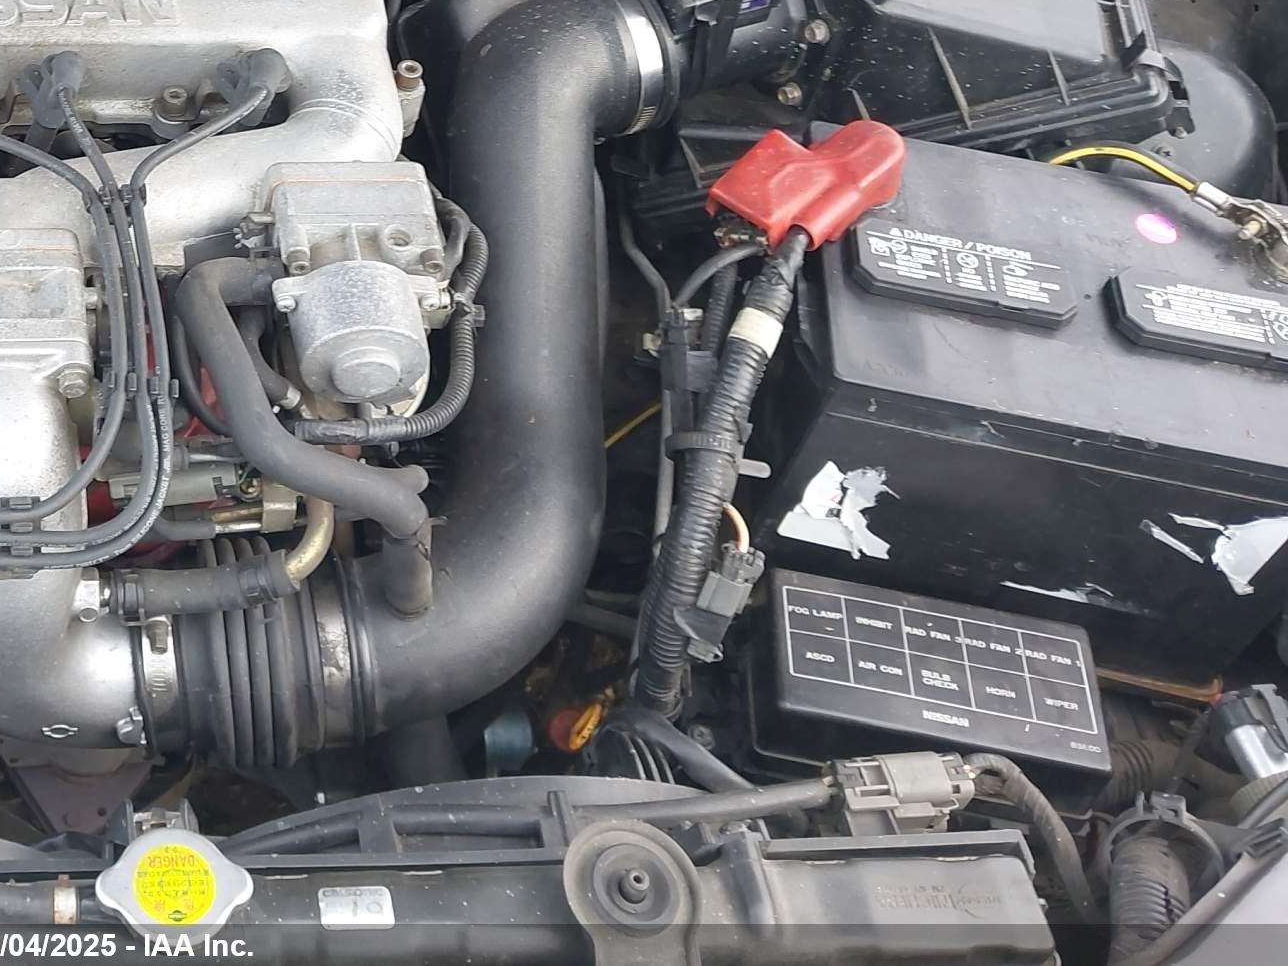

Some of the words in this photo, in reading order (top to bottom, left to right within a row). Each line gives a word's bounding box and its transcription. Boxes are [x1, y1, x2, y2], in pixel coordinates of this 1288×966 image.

[903, 229, 962, 249] DANGER
[975, 242, 1033, 261] POISON
[788, 604, 810, 616] FOG
[812, 608, 843, 620] LAMP
[903, 625, 927, 637] RAD
[929, 630, 952, 642] FAN
[963, 638, 987, 649] RAD
[989, 642, 1012, 654] FAN
[805, 651, 836, 664] ASCD
[1024, 649, 1048, 661] RAD
[1050, 654, 1073, 666] FAN
[857, 659, 878, 672] AIR
[879, 664, 904, 677] CON
[920, 669, 952, 682] BULB
[922, 677, 960, 692] CHECK
[985, 685, 1017, 699] HORN
[1043, 696, 1080, 711] WIPER
[922, 709, 970, 728] NISSAN
[147, 855, 196, 868] DANGER
